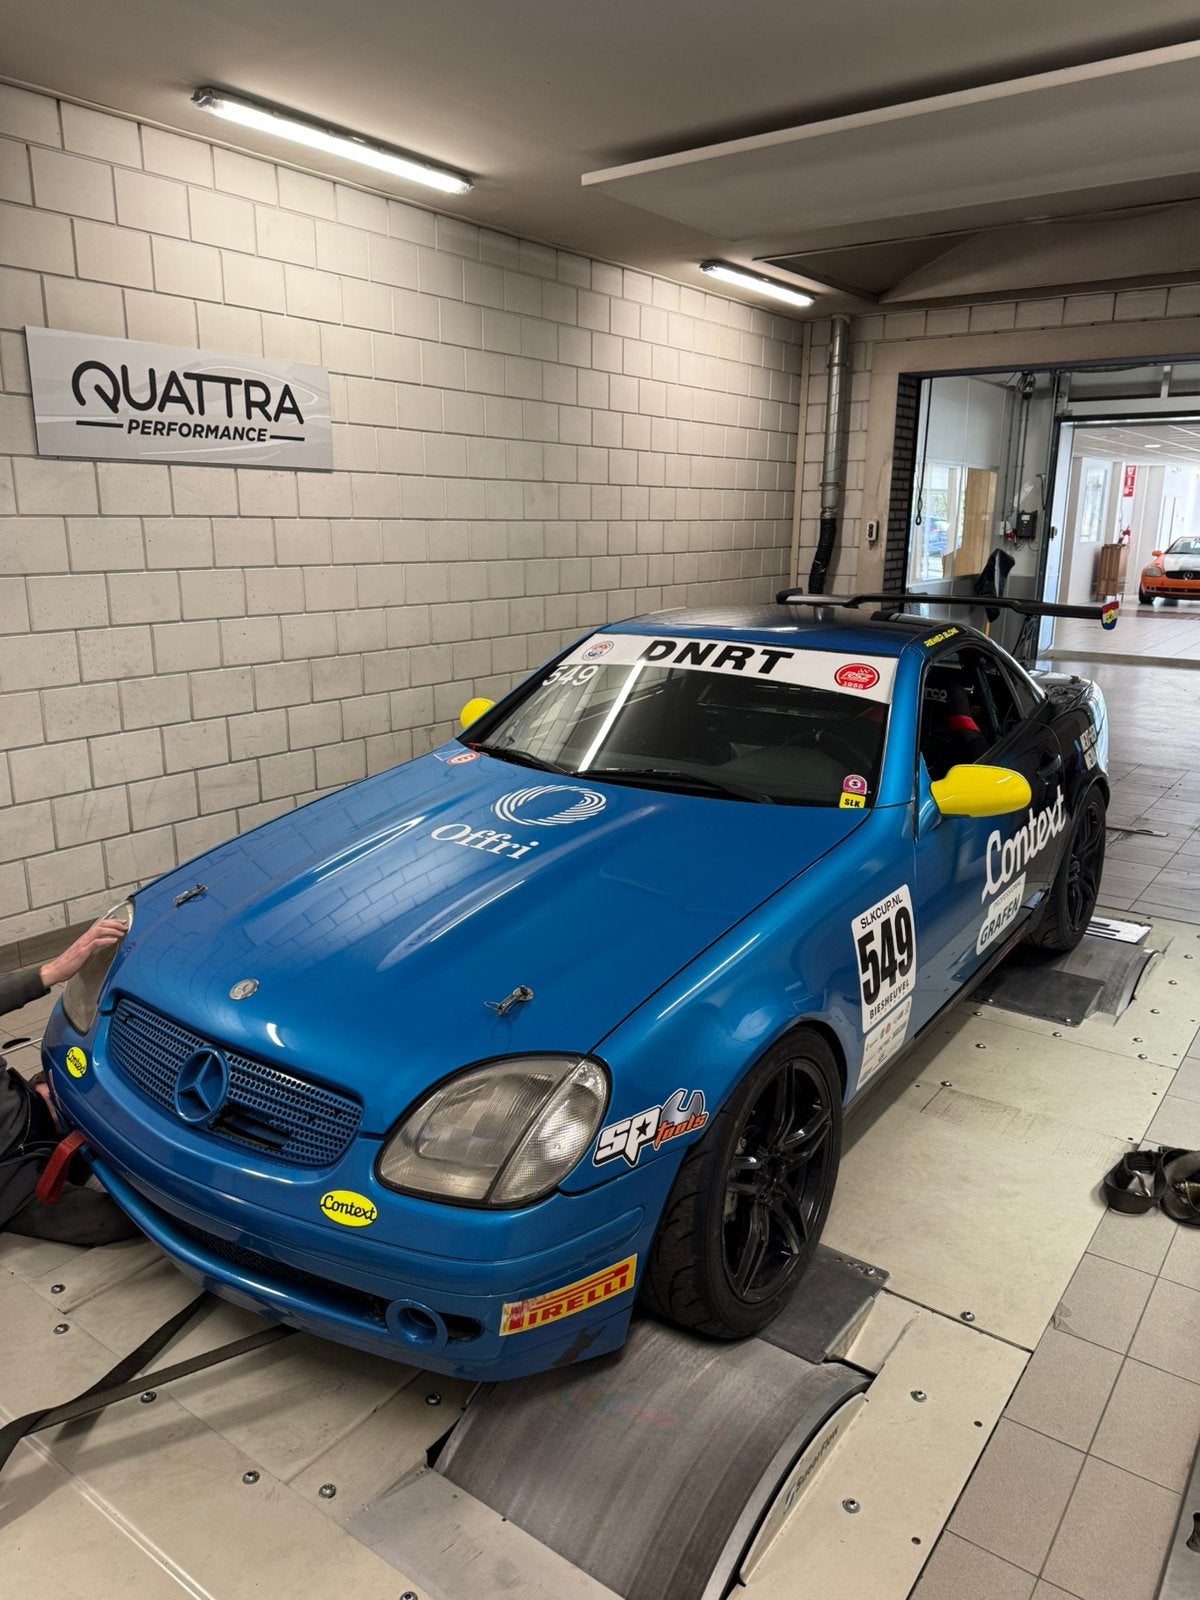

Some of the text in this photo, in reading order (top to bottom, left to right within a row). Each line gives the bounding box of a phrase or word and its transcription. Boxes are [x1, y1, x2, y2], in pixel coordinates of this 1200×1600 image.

[71, 360, 305, 425] QUATTRA
[127, 419, 268, 443] PERFORMANCE
[542, 665, 599, 686] 549
[637, 639, 794, 675] DNRT
[844, 798, 861, 808] SLK
[430, 823, 540, 860] Offri
[981, 784, 1067, 904] Context
[860, 893, 903, 930] SLKCUP.NL
[857, 906, 914, 1006] 549
[869, 979, 910, 1020] BIESHEUVEL
[653, 1112, 708, 1149] tools
[320, 1194, 376, 1221] Context
[508, 1264, 630, 1331] PIRELLI
